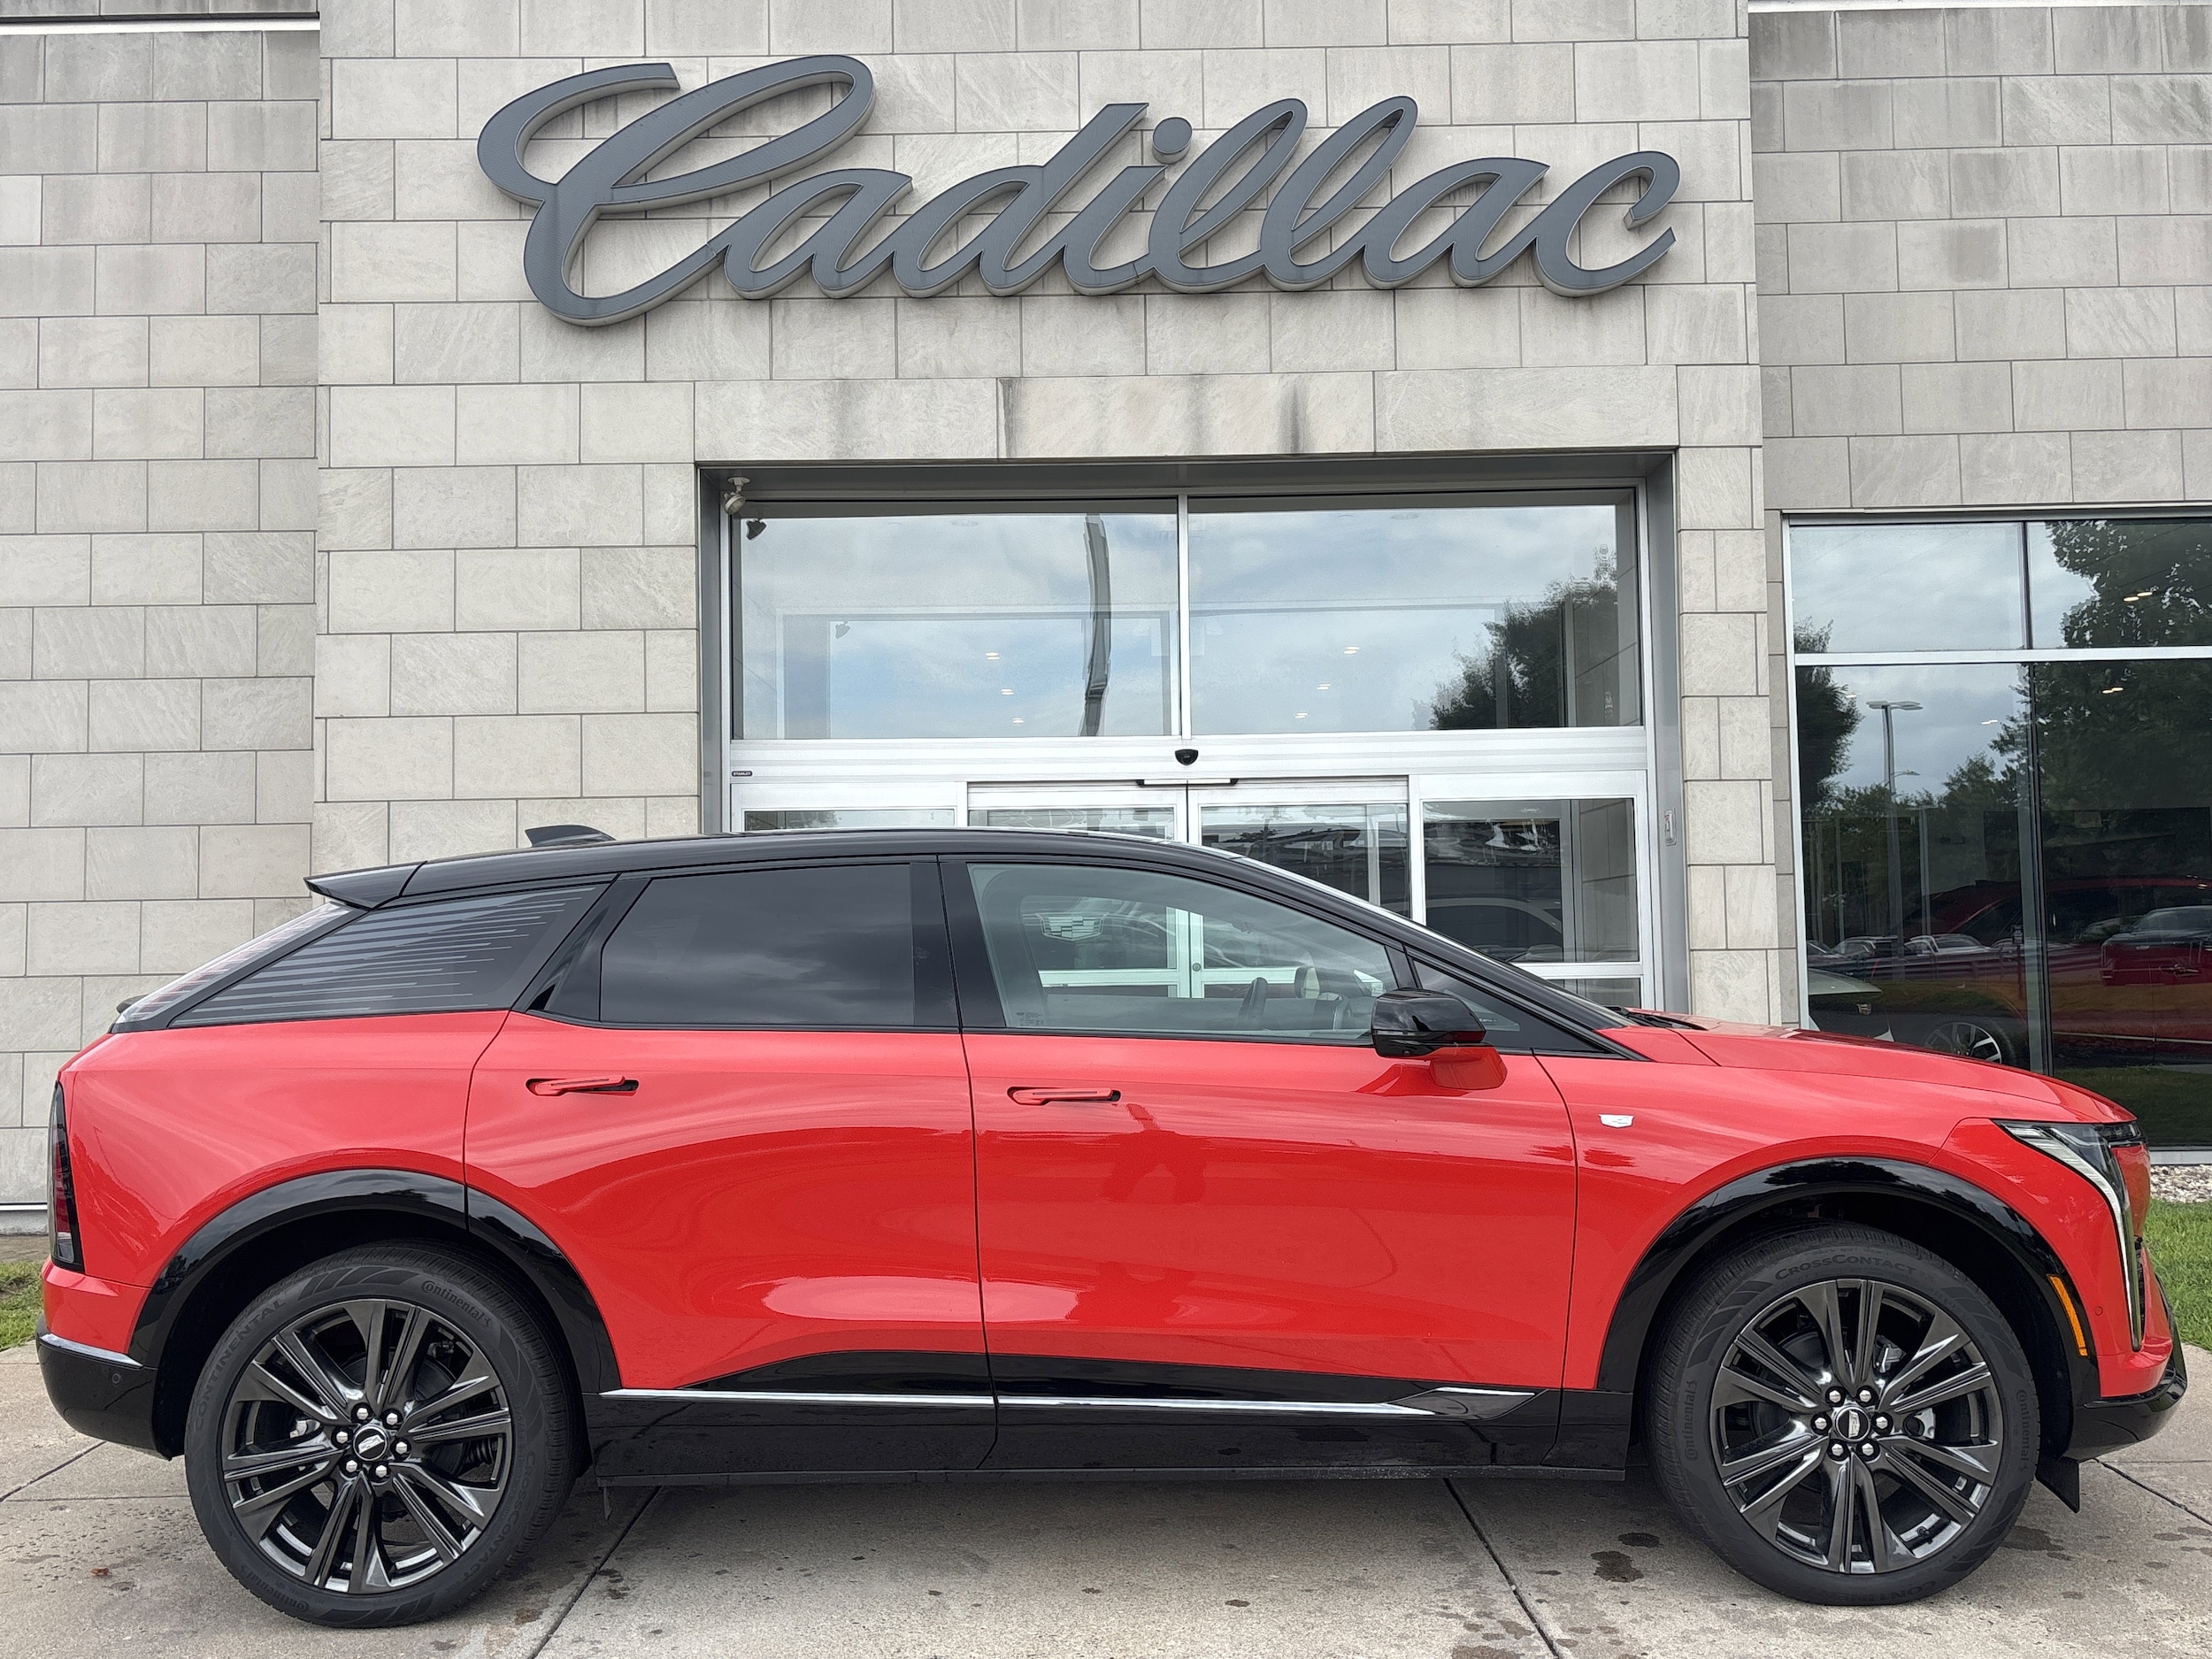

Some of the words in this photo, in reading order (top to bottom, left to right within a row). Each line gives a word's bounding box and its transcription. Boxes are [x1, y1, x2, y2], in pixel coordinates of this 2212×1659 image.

[476, 54, 1680, 326] Cadillac
[420, 1279, 486, 1322] Continental
[195, 1296, 286, 1431] CONTINENTAL
[1681, 1388, 1698, 1462] Continental
[2016, 1389, 2029, 1462] Continental
